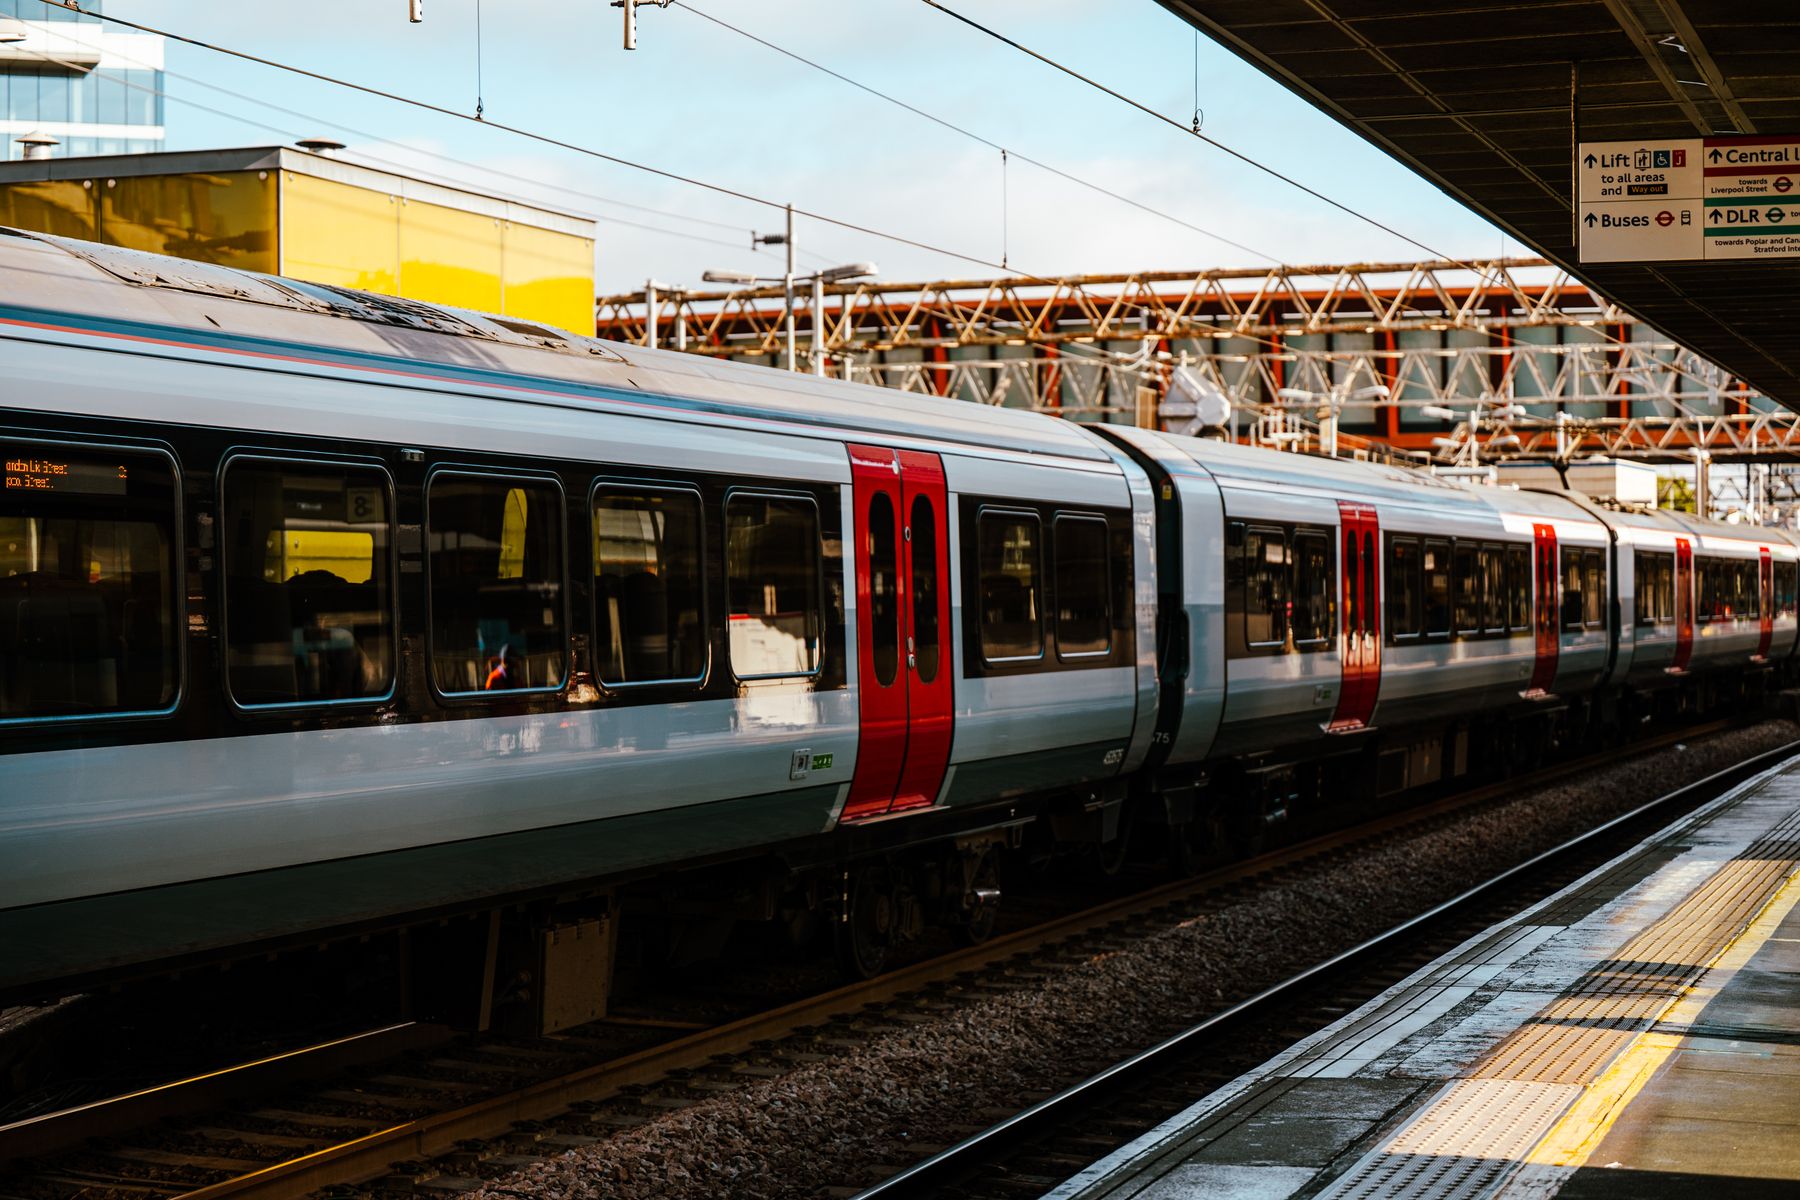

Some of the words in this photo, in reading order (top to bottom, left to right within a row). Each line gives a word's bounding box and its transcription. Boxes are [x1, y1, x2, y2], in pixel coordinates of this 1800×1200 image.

[1602, 154, 1630, 168] Lift
[1726, 148, 1789, 163] Central
[1601, 174, 1614, 183] to
[1617, 173, 1631, 183] all
[1634, 174, 1665, 182] areas
[1601, 186, 1622, 196] and
[1631, 186, 1648, 194] Way
[1711, 186, 1744, 194] Liverpool
[1602, 214, 1649, 228] Buses
[1727, 209, 1760, 223] DLR
